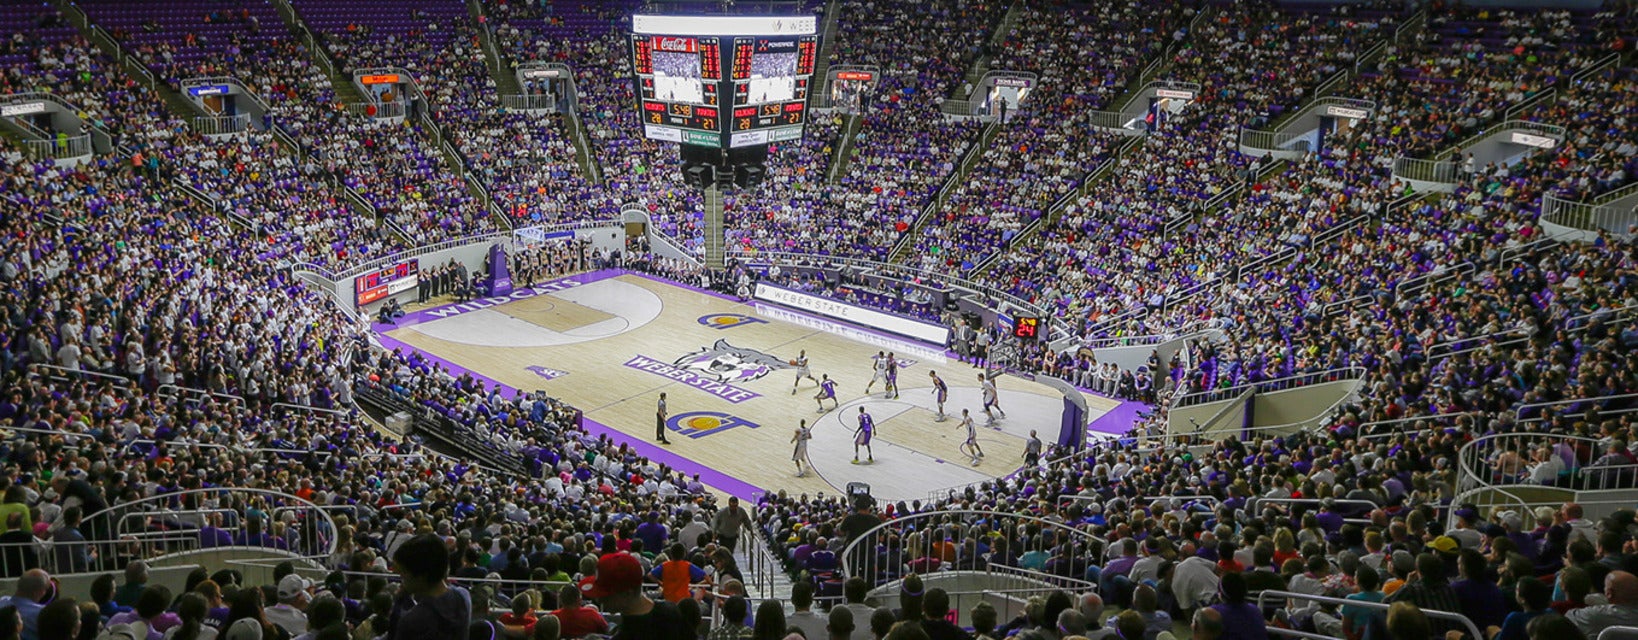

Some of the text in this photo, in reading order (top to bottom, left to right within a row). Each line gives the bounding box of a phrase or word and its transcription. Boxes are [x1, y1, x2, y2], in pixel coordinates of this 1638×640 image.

[652, 113, 662, 124] 28
[704, 119, 714, 129] 27
[789, 113, 800, 124] 27
[426, 278, 582, 318] WILDCATS
[775, 292, 849, 316] WEBER STATE
[1017, 324, 1034, 336] 24
[628, 357, 755, 402] WEBER STATE
